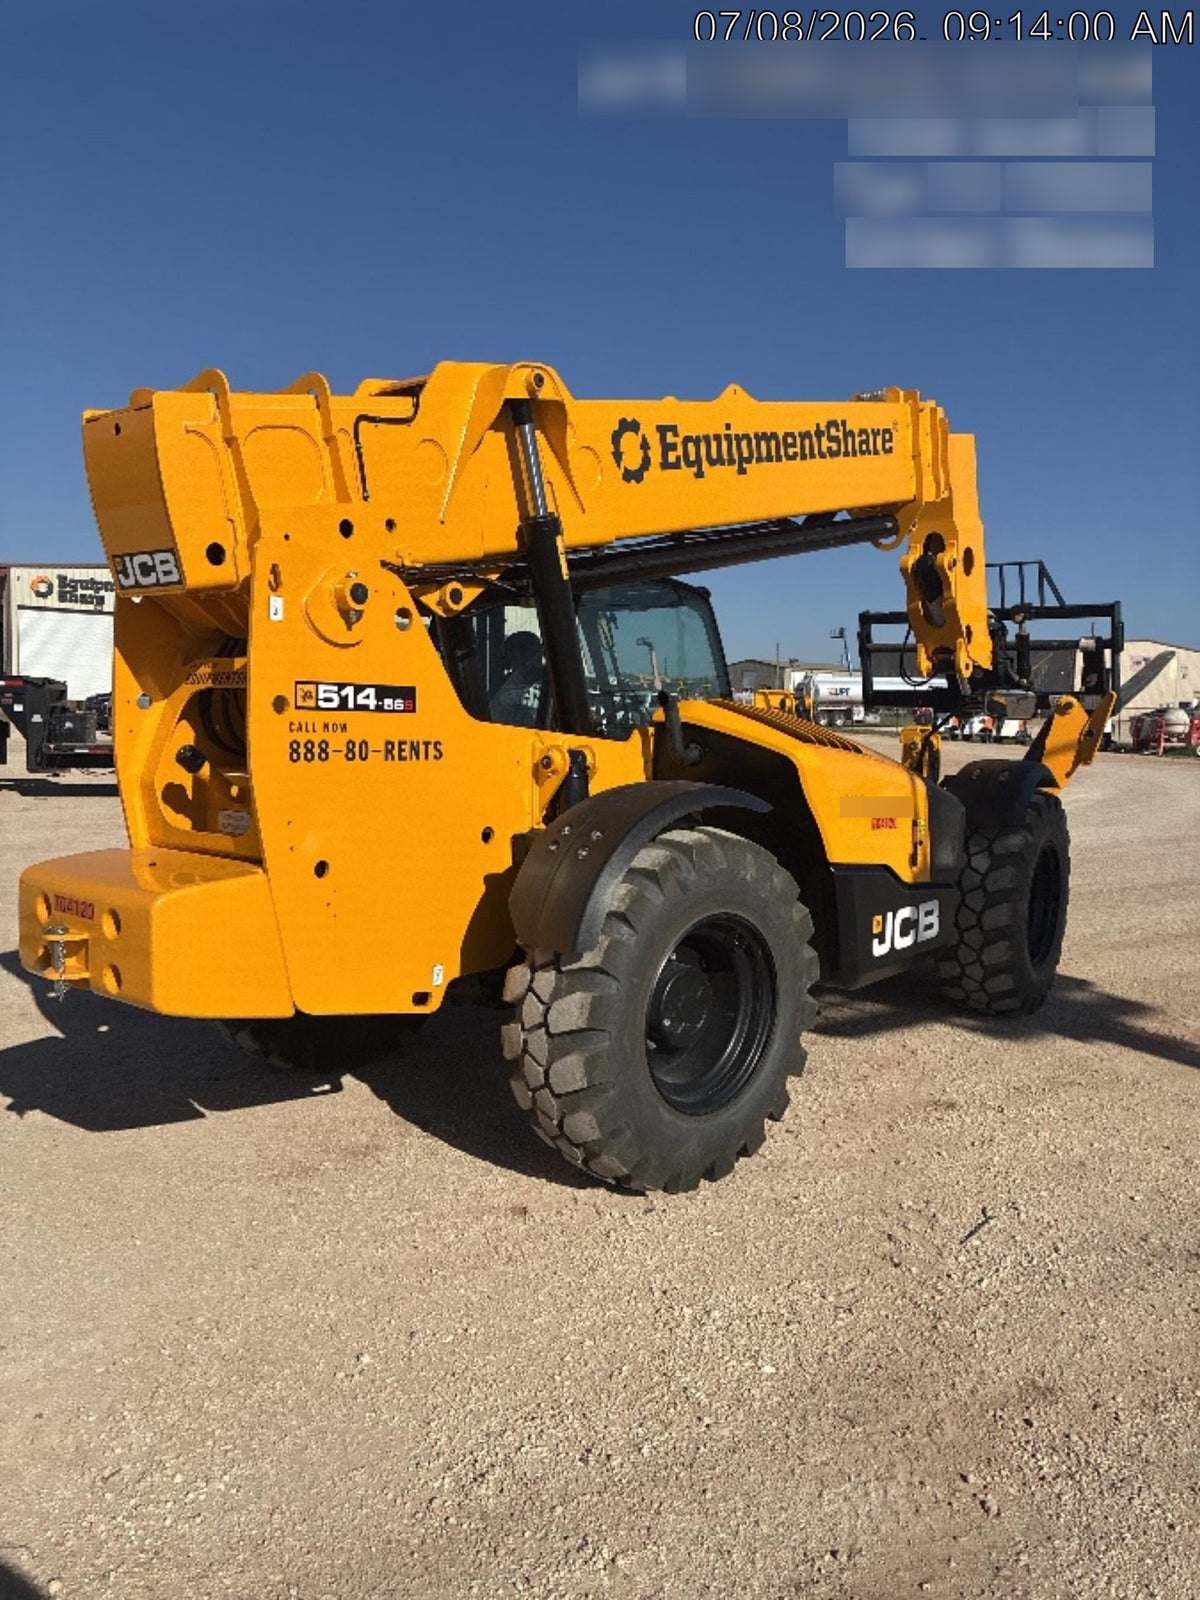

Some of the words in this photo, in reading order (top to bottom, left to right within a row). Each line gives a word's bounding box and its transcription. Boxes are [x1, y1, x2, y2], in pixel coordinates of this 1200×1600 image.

[656, 419, 893, 479] EquipmentShare
[118, 552, 180, 588] JCB
[289, 721, 317, 733] CALL
[323, 722, 347, 733] NOW
[289, 739, 443, 763] 888-80-RENTS
[872, 899, 940, 957] JCB
